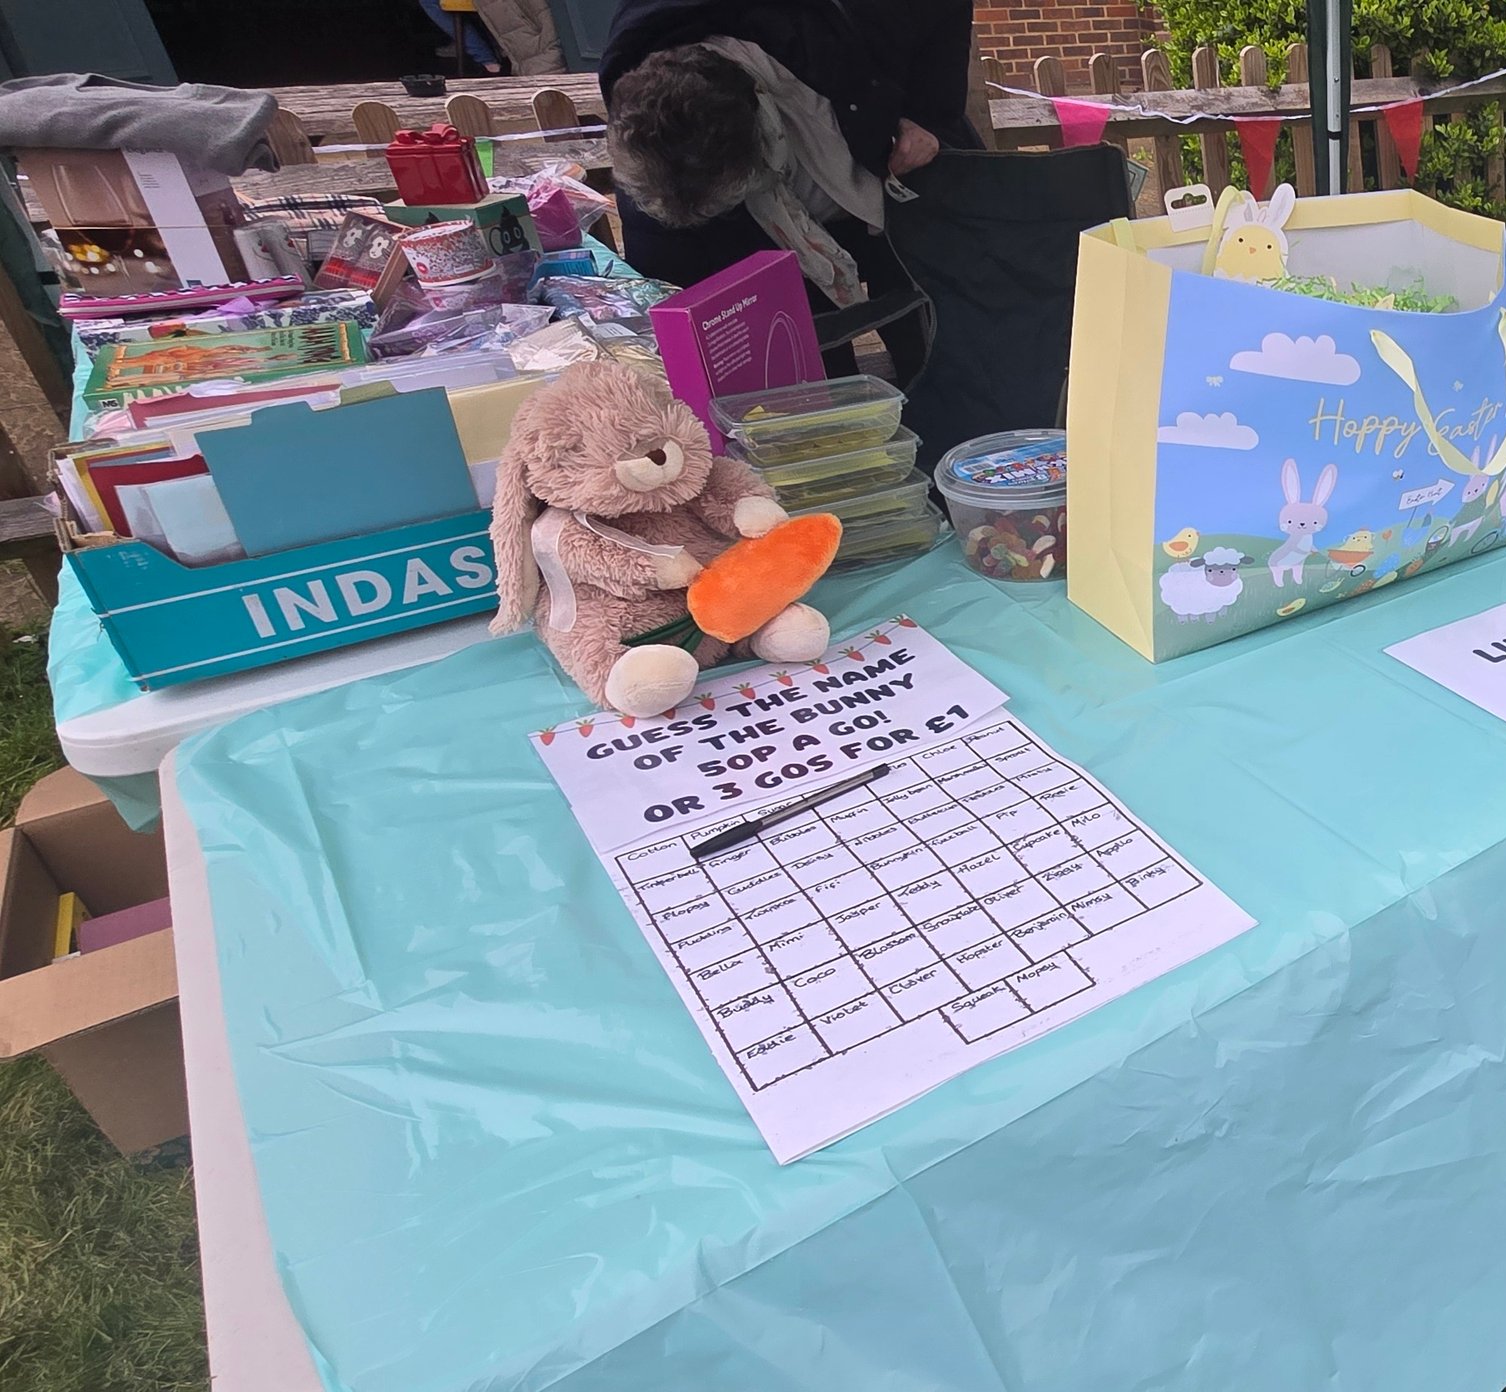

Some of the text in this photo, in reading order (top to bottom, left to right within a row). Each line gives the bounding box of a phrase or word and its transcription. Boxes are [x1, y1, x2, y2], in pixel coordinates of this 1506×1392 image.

[721, 305, 736, 319] Stand
[742, 294, 758, 308] Mirror
[586, 648, 917, 761] GUESS THE NAME
[633, 672, 915, 771] OF THE BUNNY
[697, 709, 892, 778] 50P A GO!
[922, 744, 957, 761] Chloe
[643, 704, 970, 823] OR 3 GOS FOR £1
[830, 807, 869, 823] Muffin
[690, 819, 742, 841] Pumpkin
[1012, 828, 1061, 852] Cupcake
[627, 842, 677, 861] Cotton
[709, 849, 751, 868] Ginger
[957, 853, 1002, 875] Hazel
[1041, 862, 1084, 882] Ziggy
[727, 871, 782, 895] Cuddles
[897, 879, 943, 897] Teddy
[1125, 866, 1168, 888] Binky
[662, 901, 711, 921] Flopsy
[1070, 892, 1113, 913] Mimsy
[1010, 912, 1068, 938] Benjamin
[678, 926, 732, 949] Pudding
[769, 932, 804, 952] Mimi
[956, 940, 1004, 964] Hopster
[697, 960, 744, 981] Bella
[793, 967, 836, 988] Coco
[1016, 962, 1061, 983] Mopsy
[888, 969, 937, 995] Clover
[716, 994, 775, 1020] Buddy
[951, 986, 1007, 1013] Squeak
[819, 1001, 868, 1025] Violet
[746, 1034, 797, 1059] Eddie
